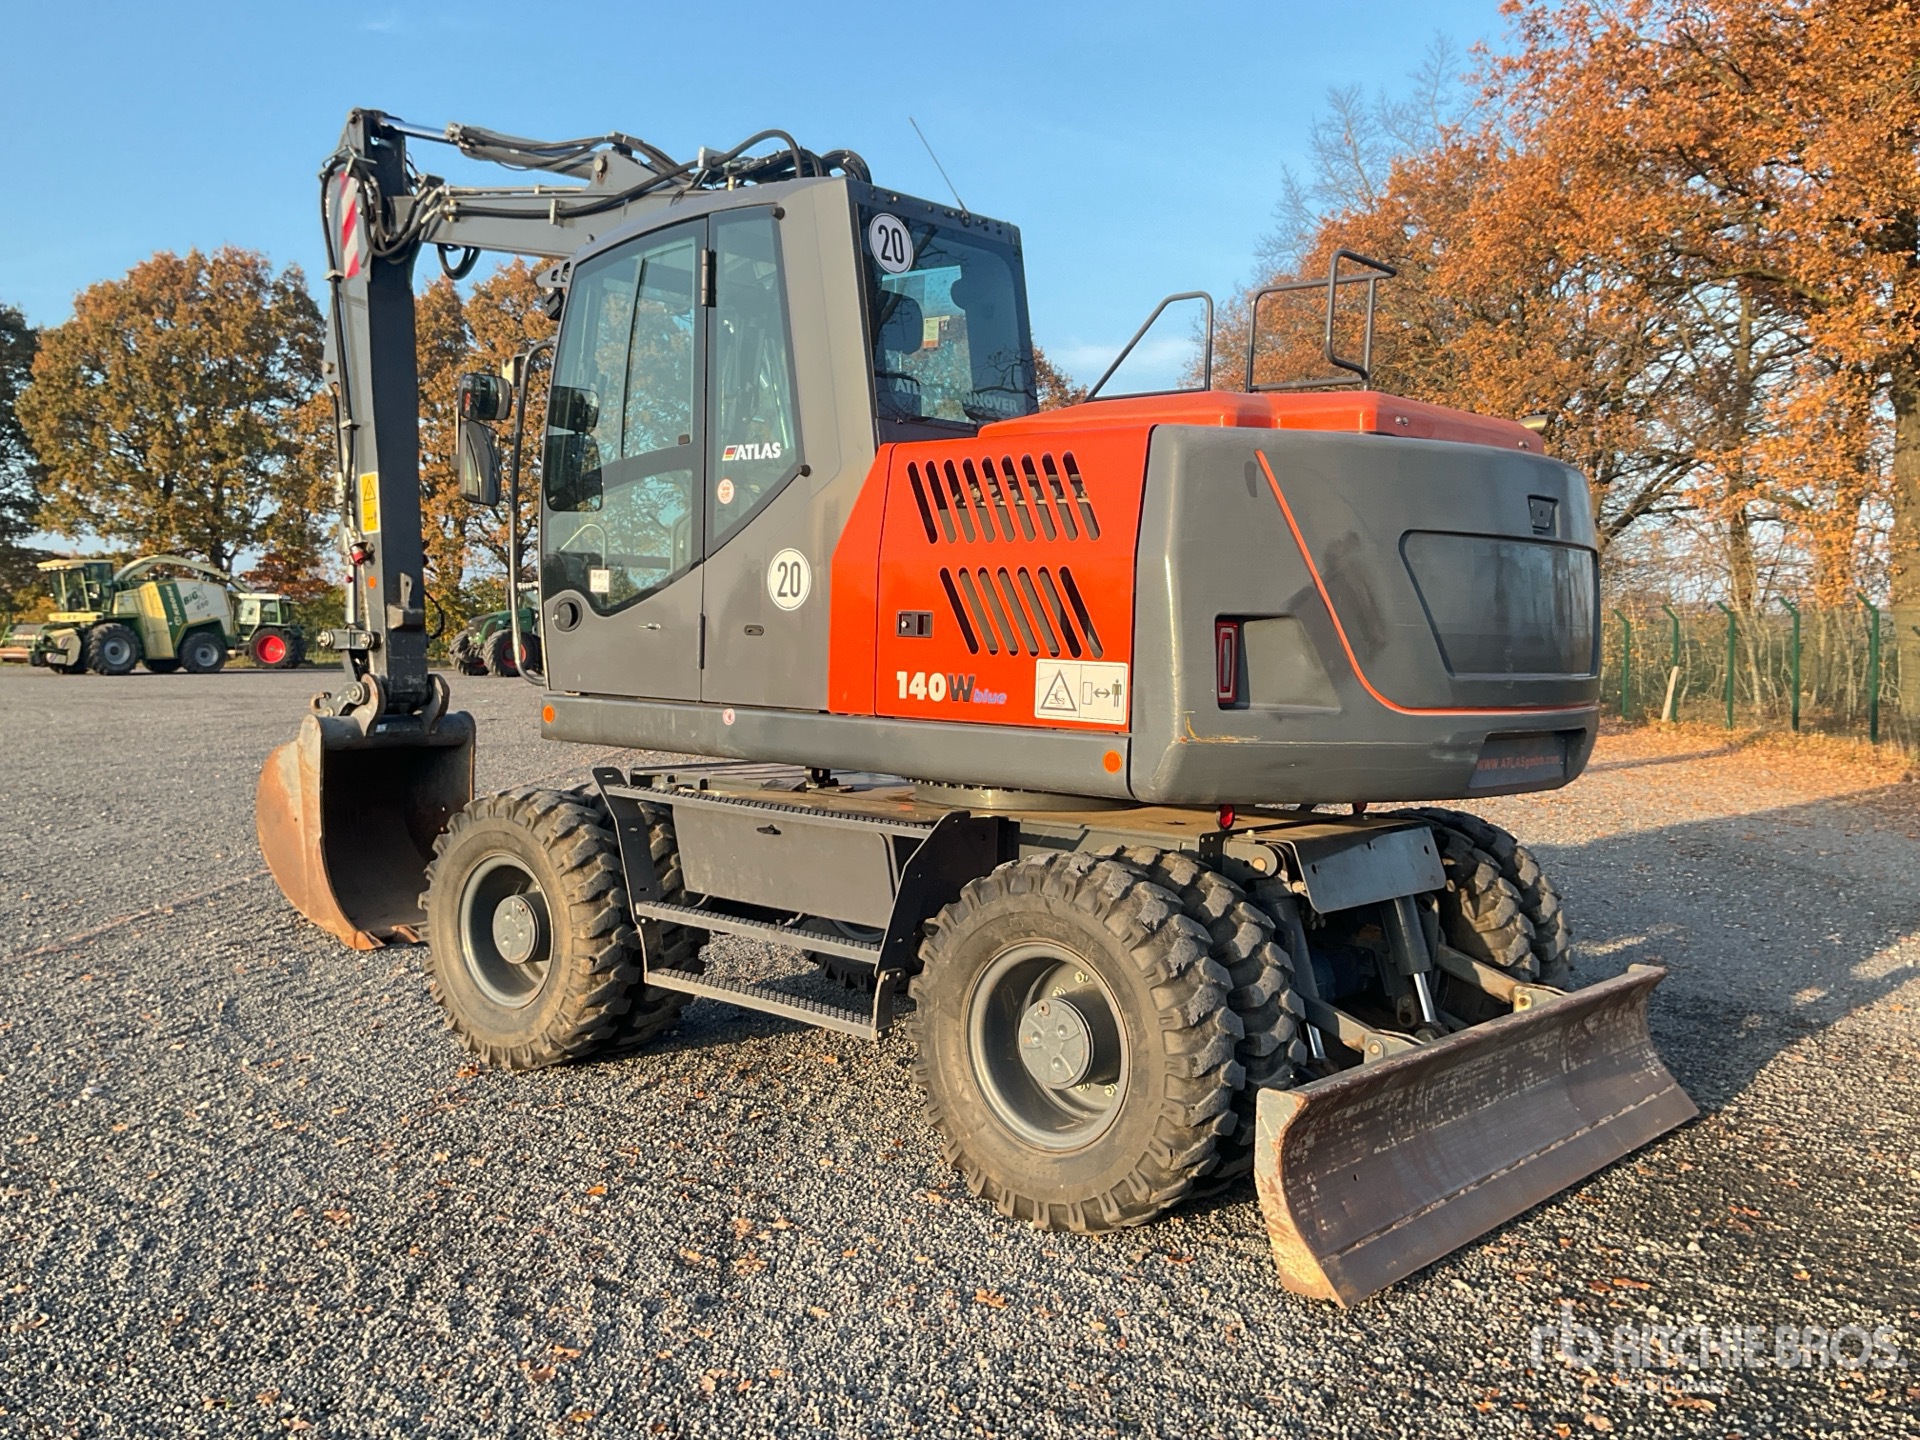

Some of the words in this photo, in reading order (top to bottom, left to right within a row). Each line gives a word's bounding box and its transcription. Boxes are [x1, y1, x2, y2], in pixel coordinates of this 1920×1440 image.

[878, 224, 905, 264] 20
[735, 442, 782, 461] ATLAS
[777, 561, 801, 598] 20
[183, 591, 198, 605] BIG
[974, 688, 1007, 704] blue
